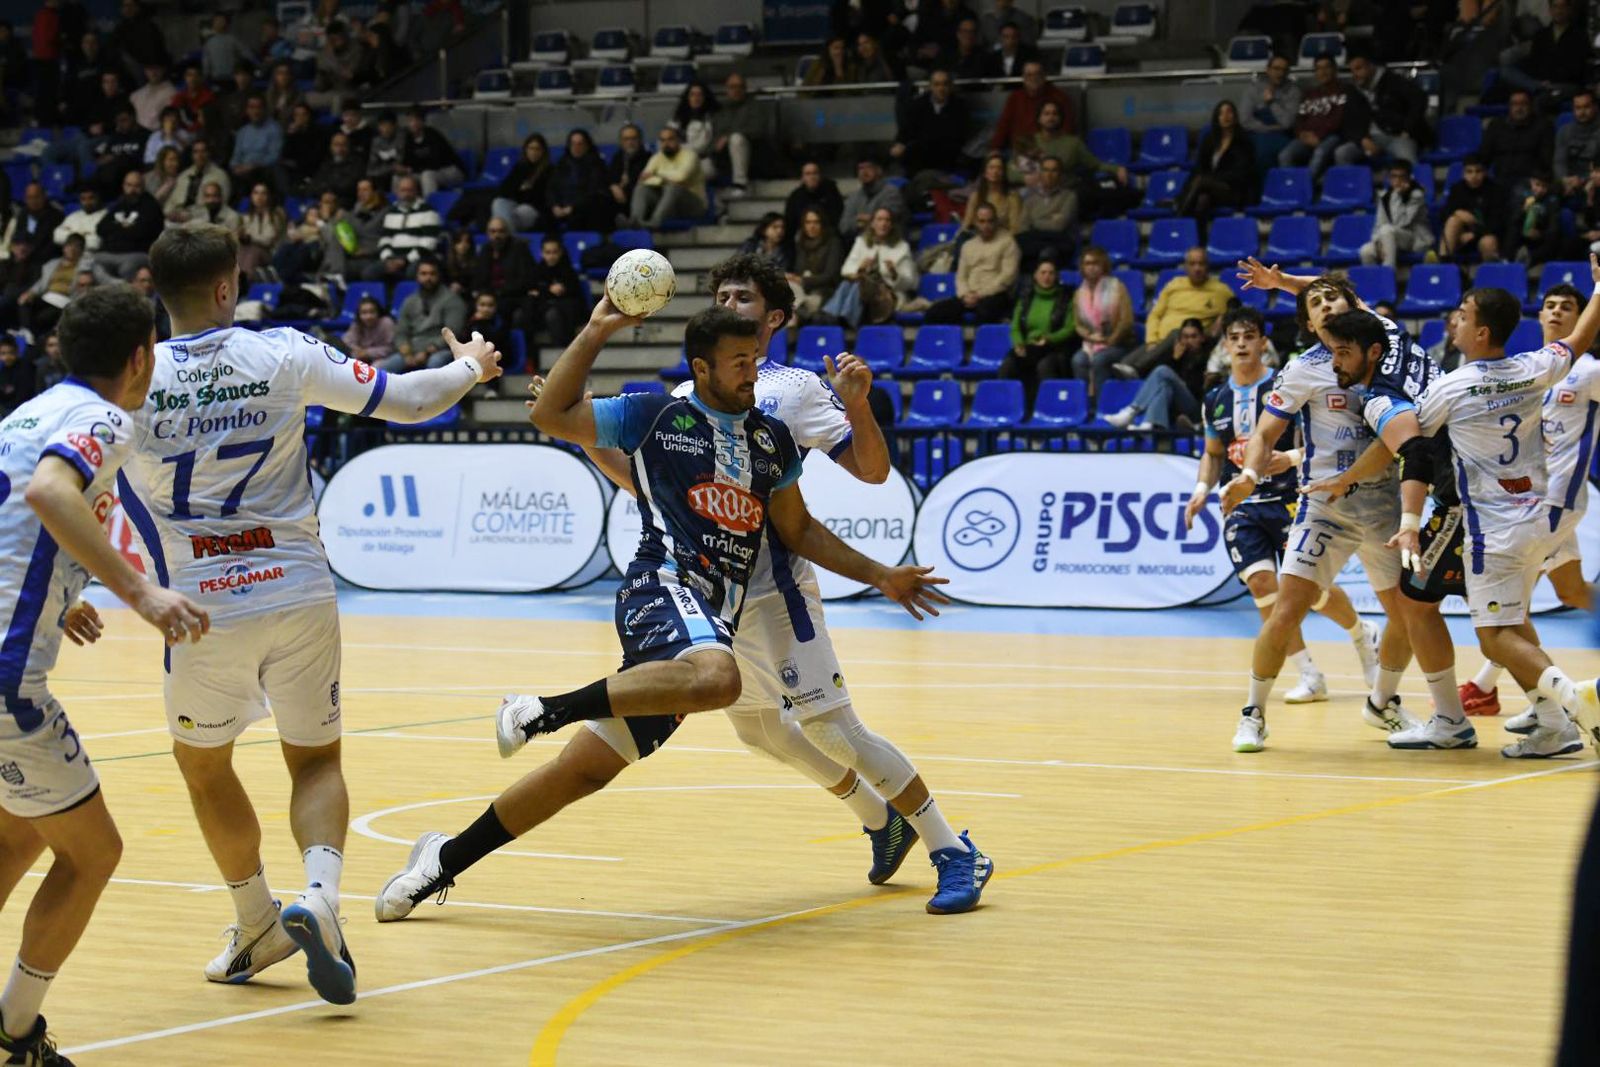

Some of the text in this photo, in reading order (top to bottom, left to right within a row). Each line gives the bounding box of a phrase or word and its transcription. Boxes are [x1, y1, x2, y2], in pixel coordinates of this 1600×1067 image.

[177, 363, 234, 383] Colegio
[196, 380, 270, 407] Sauces
[154, 408, 267, 439] C. Pombo
[655, 431, 713, 449] Fundación
[663, 441, 704, 456] Unicaja
[1499, 414, 1522, 465] 3
[714, 440, 752, 473] 55
[162, 436, 275, 520] 17
[480, 487, 569, 511] MÁLAGA
[691, 486, 763, 529] TROPS
[337, 526, 444, 539] Diputación Provincial
[472, 512, 577, 535] COMPITE
[1033, 491, 1056, 572] GRUPO
[378, 542, 415, 555] Málaga
[1293, 528, 1333, 557] 15
[199, 566, 285, 594] PESCAMAR
[1054, 562, 1216, 576] PROMOCIONES INMOBILIARIAS
